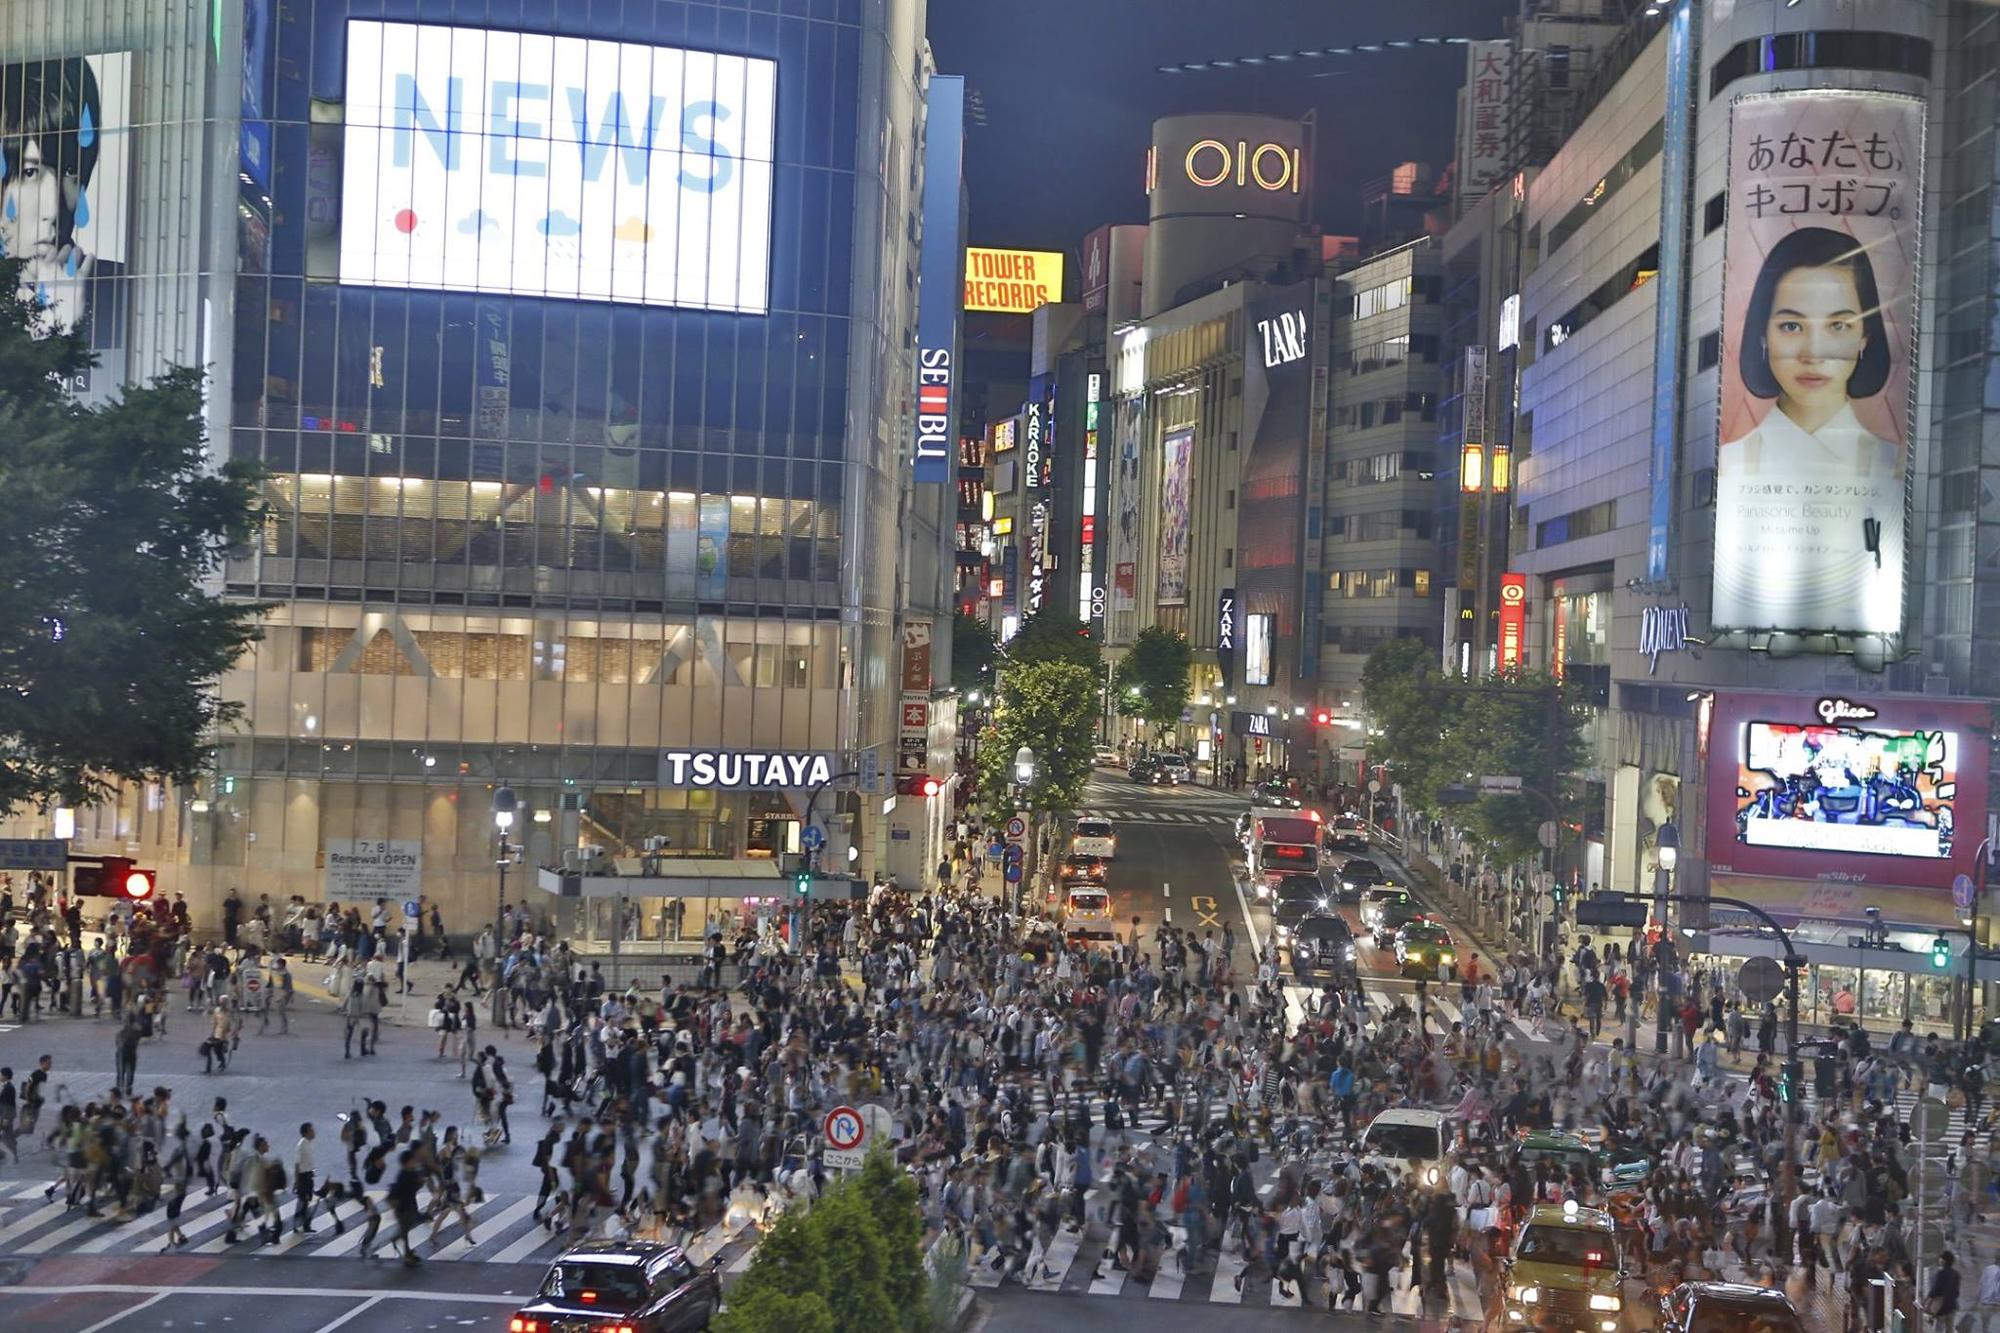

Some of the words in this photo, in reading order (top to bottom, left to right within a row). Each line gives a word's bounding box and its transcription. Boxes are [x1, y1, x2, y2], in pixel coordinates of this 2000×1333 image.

[1475, 52, 1503, 159] 大和証券
[393, 72, 733, 194] NEWS
[970, 252, 1036, 281] TOWER
[964, 280, 1048, 309] RECORDS
[1026, 403, 1040, 487] KARAOKE
[1802, 504, 1851, 520] Beauty
[1220, 599, 1233, 649] ZARA
[906, 706, 923, 724] 本
[1249, 715, 1269, 735] ZARA
[1819, 700, 1876, 724] Glico
[667, 753, 831, 786] TSUTAYA
[331, 853, 380, 865] Renewal
[383, 854, 417, 866] OPEN
[825, 1153, 862, 1167] ここから
